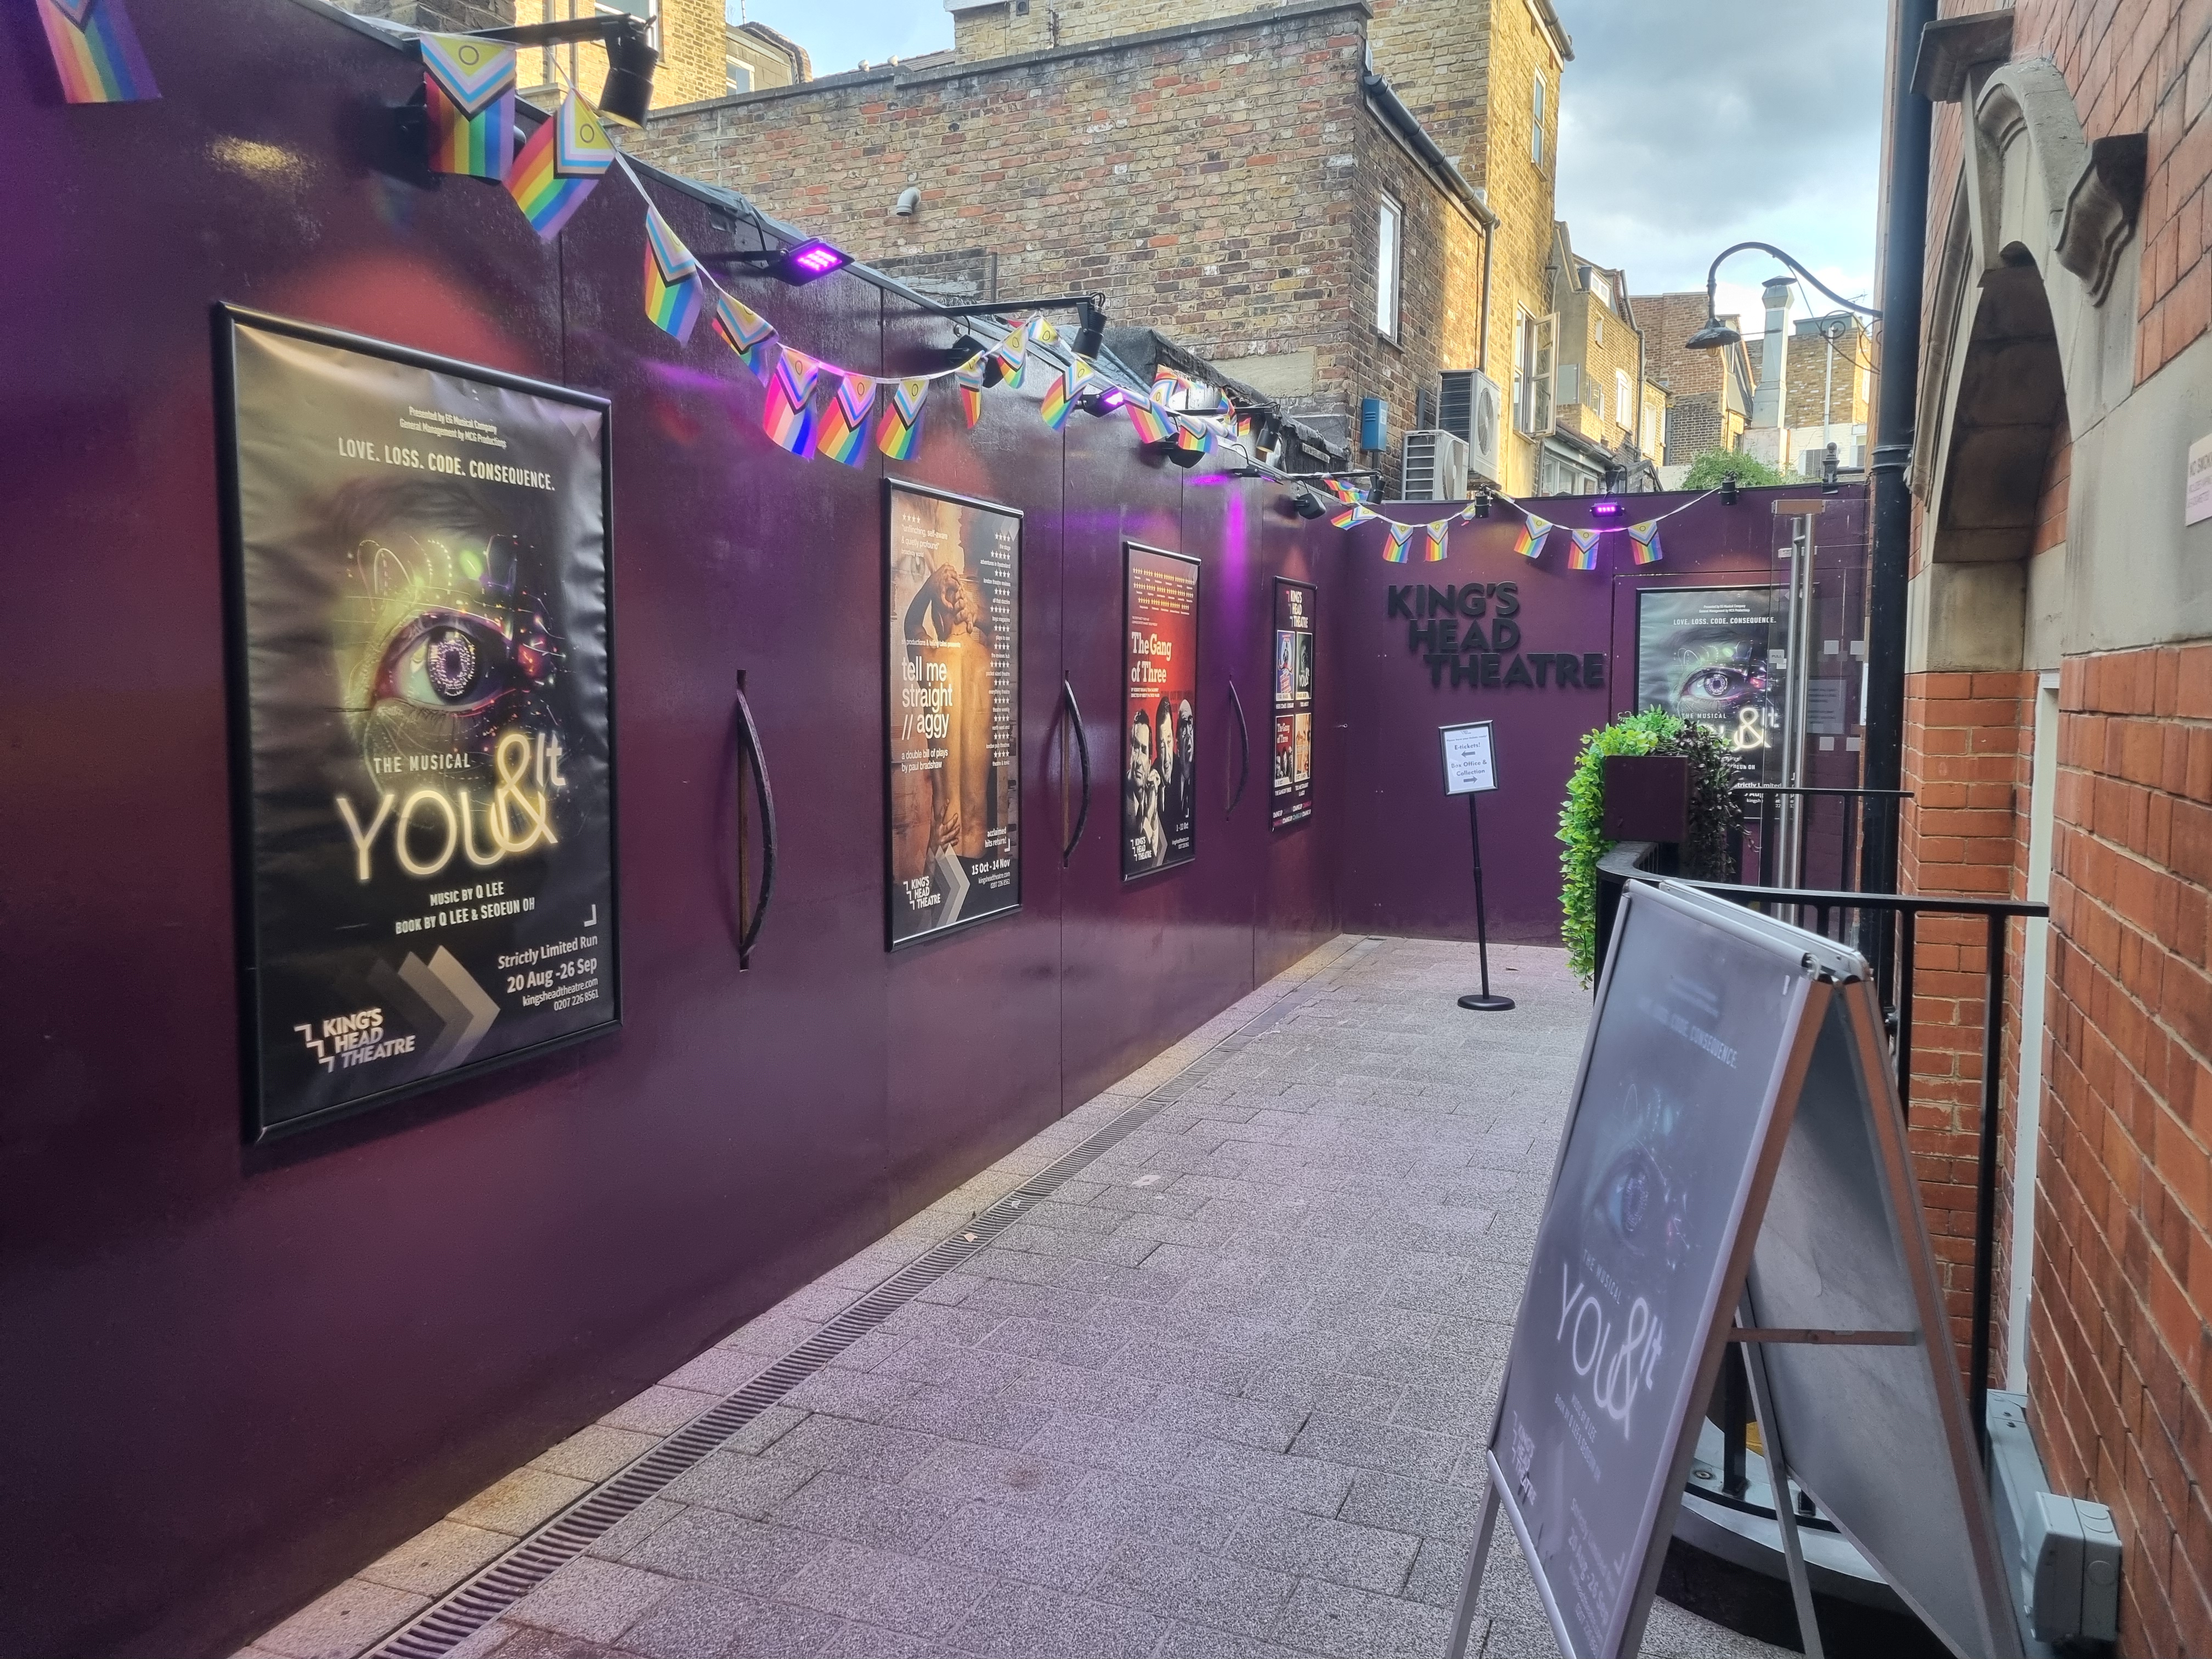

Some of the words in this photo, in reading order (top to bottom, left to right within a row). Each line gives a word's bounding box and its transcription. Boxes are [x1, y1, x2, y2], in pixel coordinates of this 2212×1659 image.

[409, 406, 437, 420] Presented
[438, 412, 445, 425] by
[453, 415, 475, 428] Musical
[474, 420, 498, 435] Company
[399, 419, 422, 431] General
[422, 422, 458, 437] Management
[458, 430, 465, 441] by
[477, 434, 507, 449] Productions
[338, 437, 381, 462] LOVE.
[384, 444, 425, 470] LOSS.
[428, 452, 466, 476] CODE.
[469, 459, 556, 491] CONSEQUENCE.
[901, 535, 905, 544] &
[905, 537, 919, 548] quietly
[927, 529, 948, 540] self-aware
[1291, 590, 1302, 603] KING'S
[1387, 581, 1520, 617] KING'S
[1293, 603, 1302, 615] HEAD
[1294, 616, 1308, 628] THEATRE
[1132, 631, 1149, 654] The
[1150, 633, 1172, 662] Gang
[1409, 618, 1521, 651] HEAD
[902, 656, 922, 681] tell
[927, 662, 947, 681] me
[1131, 661, 1141, 682] of
[1142, 661, 1167, 683] Three
[1423, 653, 1605, 687] THEATRE
[902, 682, 952, 713] straight
[917, 714, 949, 739] aggy
[374, 757, 402, 774] THE
[409, 753, 471, 772] MUSICAL
[906, 749, 922, 759] double
[930, 748, 936, 758] of
[936, 748, 949, 759] plays
[901, 763, 907, 774] by
[909, 761, 919, 773] paul
[919, 760, 943, 770] bradshaw
[985, 839, 993, 848] hits
[993, 836, 1007, 847] return!
[988, 826, 1007, 837] acclaimed
[1137, 844, 1146, 853] HEAD
[1138, 850, 1152, 860] THEATRE
[972, 864, 979, 875] 15
[979, 861, 989, 873] Oct
[992, 859, 999, 870] 14
[1000, 858, 1010, 868] Nov
[430, 891, 460, 906] MUSIC
[461, 888, 473, 901] BY
[476, 884, 483, 899] Q
[486, 882, 504, 897] LEE
[911, 876, 929, 889] KING'S
[915, 887, 930, 899] HEAD
[917, 893, 941, 909] THEATRE
[396, 918, 422, 934] BOOK
[424, 916, 436, 930] BY
[439, 913, 447, 927] Q
[450, 908, 469, 924] LEE
[471, 908, 478, 921] &
[481, 900, 520, 919] SEOEUN
[522, 897, 535, 911] OH
[498, 948, 539, 970] Strictly
[540, 937, 578, 959] Limited
[580, 935, 597, 949] Run
[506, 973, 524, 994] 20
[527, 970, 553, 988] Aug
[577, 957, 597, 974] Sep
[523, 978, 599, 1007] kingsheadtheatre.com
[554, 998, 571, 1011] 0207
[572, 994, 584, 1006] 226
[584, 989, 599, 1002] 8561
[323, 1008, 383, 1037] KING'S
[335, 1027, 384, 1053] HEAD
[341, 1035, 416, 1069] THEATRE
[1596, 1264, 1622, 1305] MUSICAL
